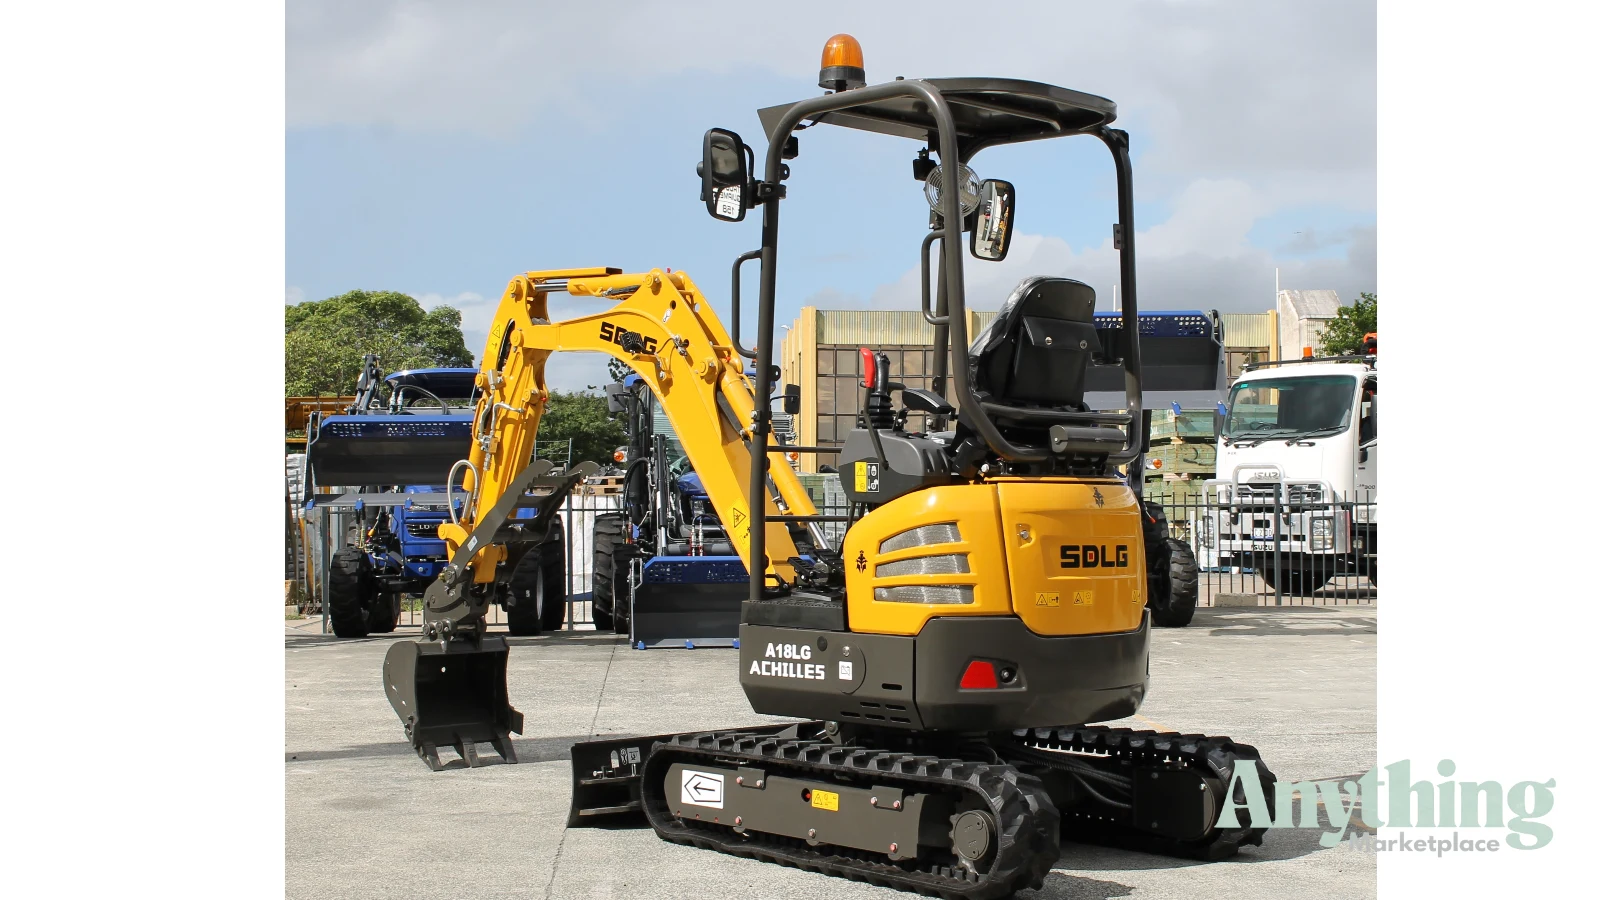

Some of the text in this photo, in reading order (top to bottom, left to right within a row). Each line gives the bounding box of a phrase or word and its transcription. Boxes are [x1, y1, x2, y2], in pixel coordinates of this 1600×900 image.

[599, 321, 658, 355] SDG
[1254, 471, 1281, 480] ISUZ
[1060, 545, 1128, 568] SDLG
[765, 642, 812, 660] A18LG
[749, 660, 826, 680] ACHILLES
